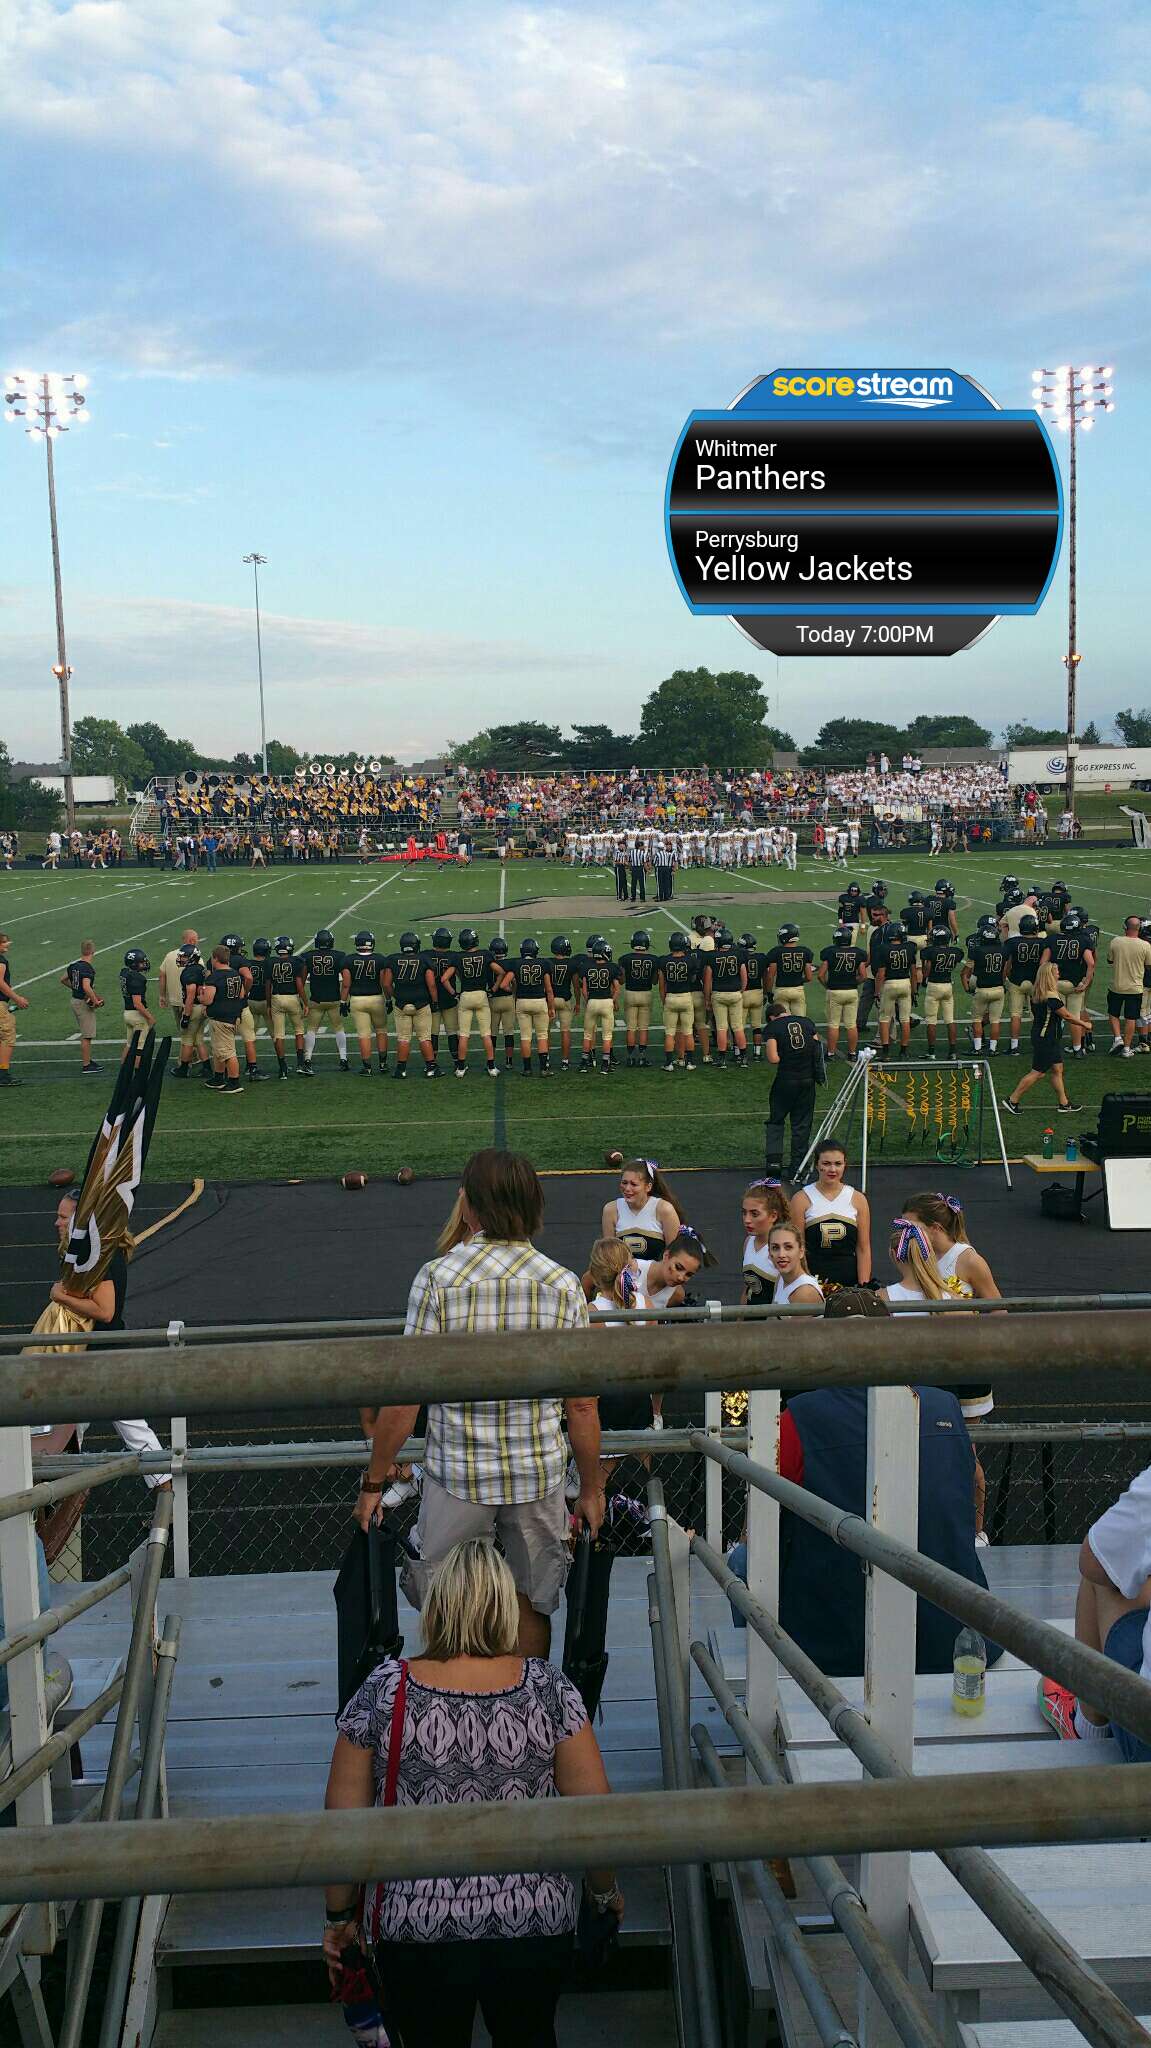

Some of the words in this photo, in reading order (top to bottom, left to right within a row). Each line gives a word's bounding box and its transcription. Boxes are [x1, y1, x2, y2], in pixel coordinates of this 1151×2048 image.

[1090, 763, 1121, 771] EXPRESS
[1122, 762, 1137, 770] INC.
[889, 949, 908, 970] 31
[1018, 942, 1040, 962] 84
[1056, 939, 1080, 959] 78
[272, 962, 294, 984] 42
[312, 955, 334, 976] 52
[353, 960, 376, 980] 74
[397, 959, 420, 980] 77
[462, 955, 484, 978] 57
[666, 961, 688, 982] 82
[716, 956, 738, 978] 73
[782, 952, 804, 973] 55
[835, 952, 856, 973] 75
[934, 953, 956, 973] 24
[985, 952, 1003, 973] 18
[520, 964, 542, 986] 62
[588, 968, 610, 989] 28
[787, 1021, 805, 1050] 8
[820, 1222, 847, 1249] P
